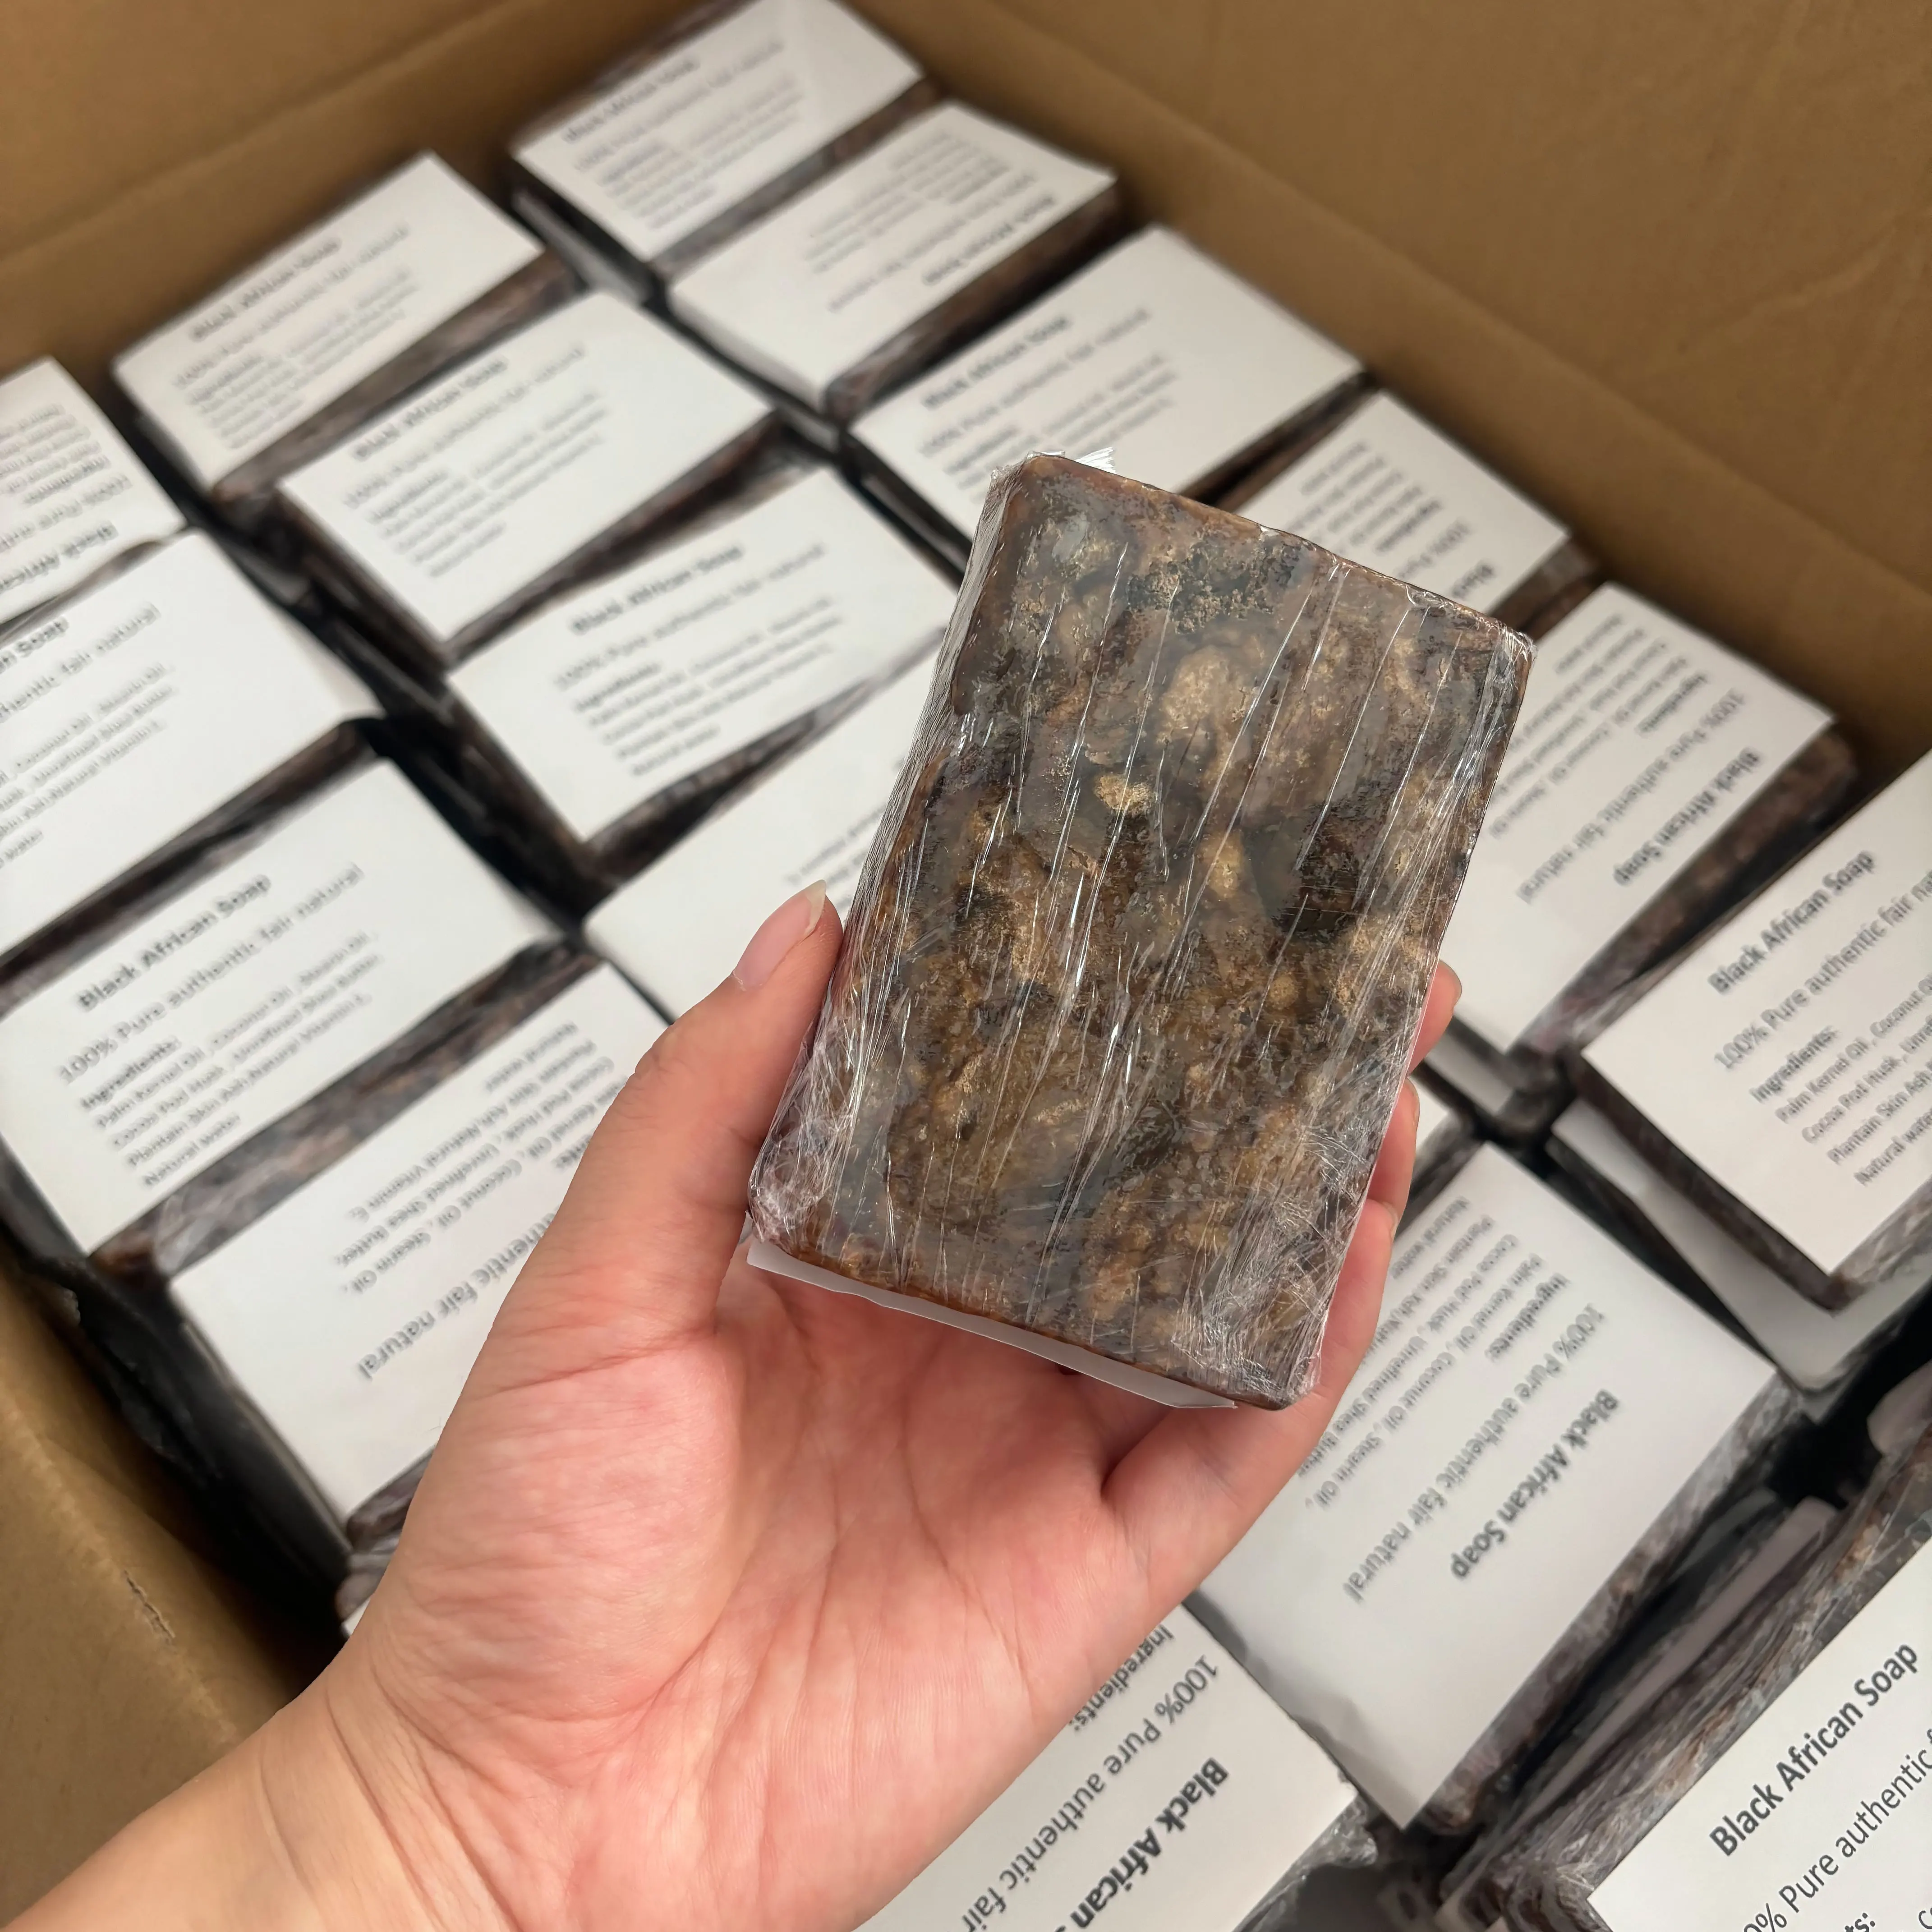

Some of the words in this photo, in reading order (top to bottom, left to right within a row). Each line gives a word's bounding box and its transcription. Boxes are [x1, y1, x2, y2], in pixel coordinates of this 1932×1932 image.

[77, 966, 139, 1011] Black
[140, 913, 217, 969] African
[216, 876, 271, 917] Soap
[1708, 947, 1766, 994] Black
[1762, 890, 1830, 951] African
[1823, 852, 1875, 894] Soap
[59, 1038, 117, 1083] 100%
[115, 1003, 165, 1040] Pure
[167, 943, 260, 1008] authentic
[1715, 1024, 1770, 1070] 100%
[1761, 990, 1809, 1030] Pure
[1805, 920, 1887, 994] authentic
[1878, 896, 1913, 926] fair
[1776, 1092, 1812, 1123] Palm
[439, 1282, 478, 1317] fair
[1553, 1304, 1605, 1359] 100%
[358, 1312, 436, 1380] natural
[1514, 1354, 1563, 1402] Pure
[1436, 1398, 1518, 1490] authentic
[1562, 1390, 1619, 1449] Black
[1408, 1488, 1447, 1526] fair
[1498, 1445, 1569, 1524] African
[1343, 1523, 1411, 1603] natural
[1451, 1521, 1507, 1580] Soap
[1067, 1625, 1173, 1731] Ingredients:
[1155, 1656, 1217, 1724] 100%
[1104, 1719, 1161, 1776] Pure
[1710, 1785, 1784, 1856] Black
[1776, 1702, 1863, 1792] African
[1854, 1645, 1917, 1707] Soap
[999, 1774, 1105, 1890] authentic
[1155, 1758, 1228, 1833] Black
[1779, 1855, 1839, 1913] Pure
[1835, 1750, 1932, 1858] authentic
[962, 1887, 1006, 1932] fair
[1070, 1828, 1161, 1929] African
